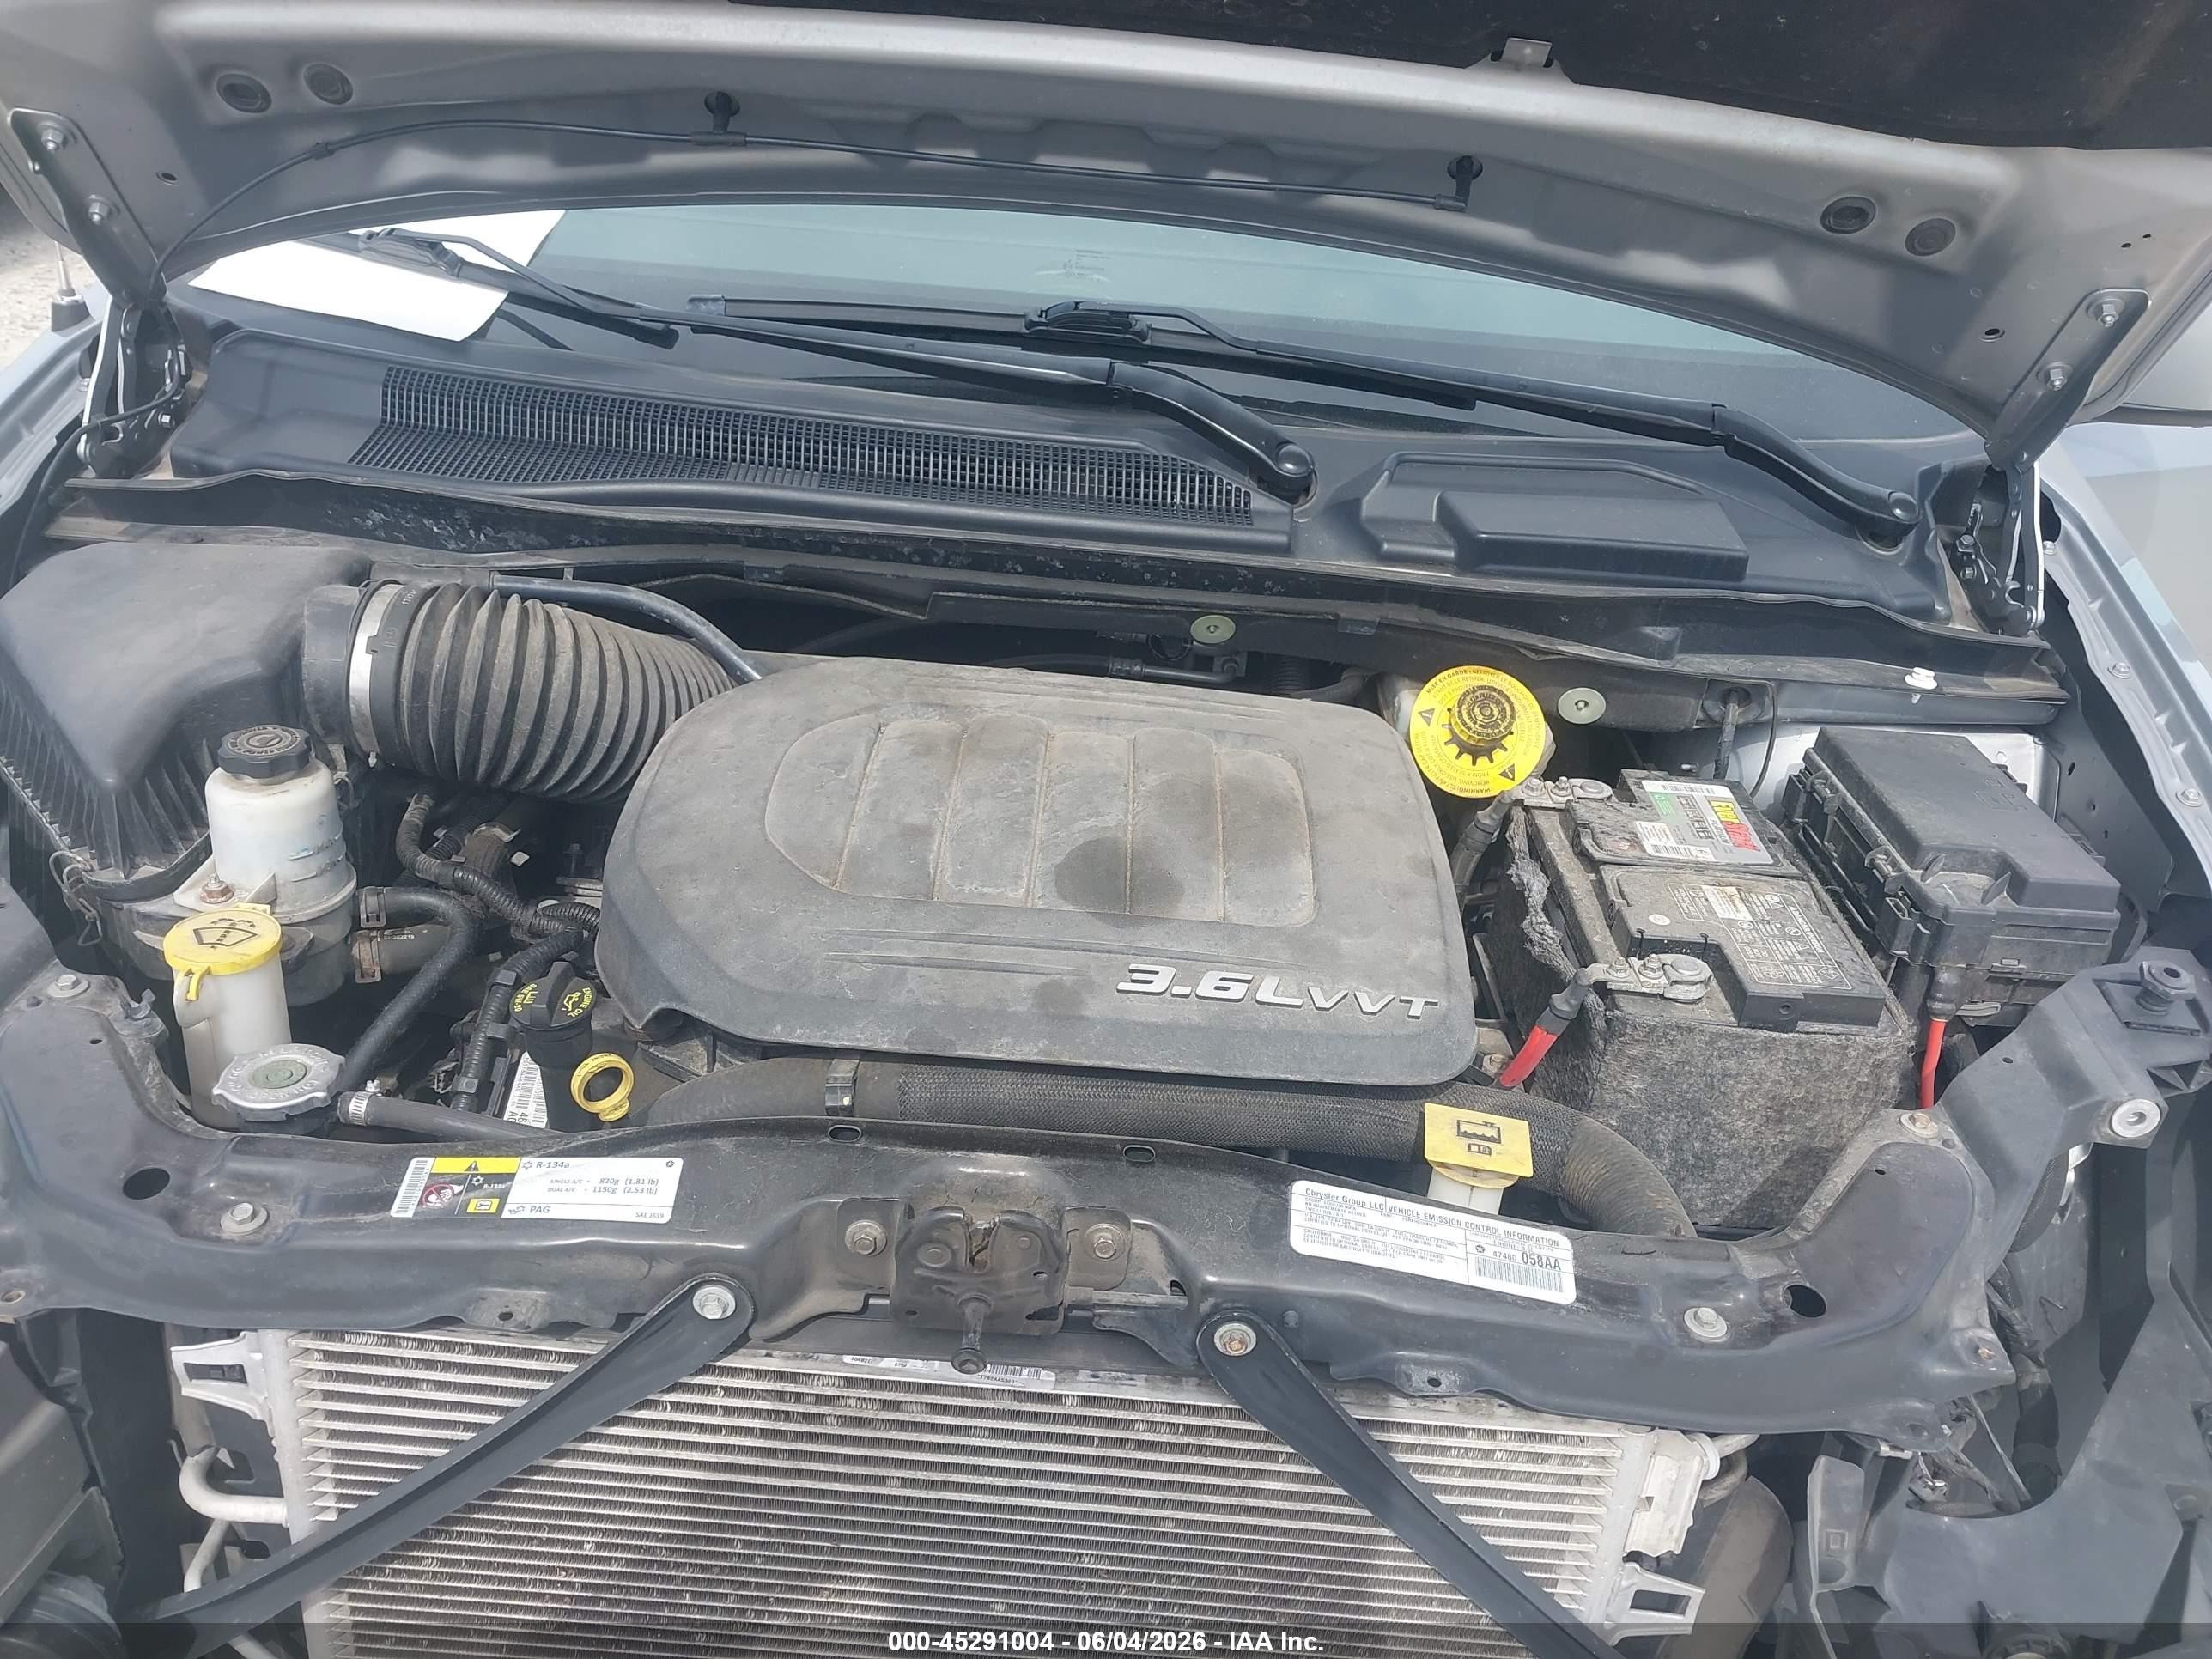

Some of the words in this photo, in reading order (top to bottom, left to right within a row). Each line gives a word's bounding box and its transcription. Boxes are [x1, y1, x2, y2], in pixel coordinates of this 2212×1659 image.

[581, 987, 592, 1010] ENGINE
[567, 1008, 584, 1018] OIL
[599, 1177, 619, 1186] 820g
[624, 1177, 645, 1186] (1.81
[647, 1177, 659, 1186] lb)
[646, 1187, 658, 1195] lb)
[1306, 1188, 1339, 1201] Chrysler
[1341, 1195, 1366, 1208] Group
[1369, 1202, 1384, 1211] LLC
[1388, 1206, 1420, 1218] VEHICLE
[1424, 1212, 1462, 1226] EMISSION
[1465, 1221, 1501, 1234] CONTROL
[1504, 1229, 1559, 1247] INFORMATION
[1522, 1252, 1561, 1271] 058AA
